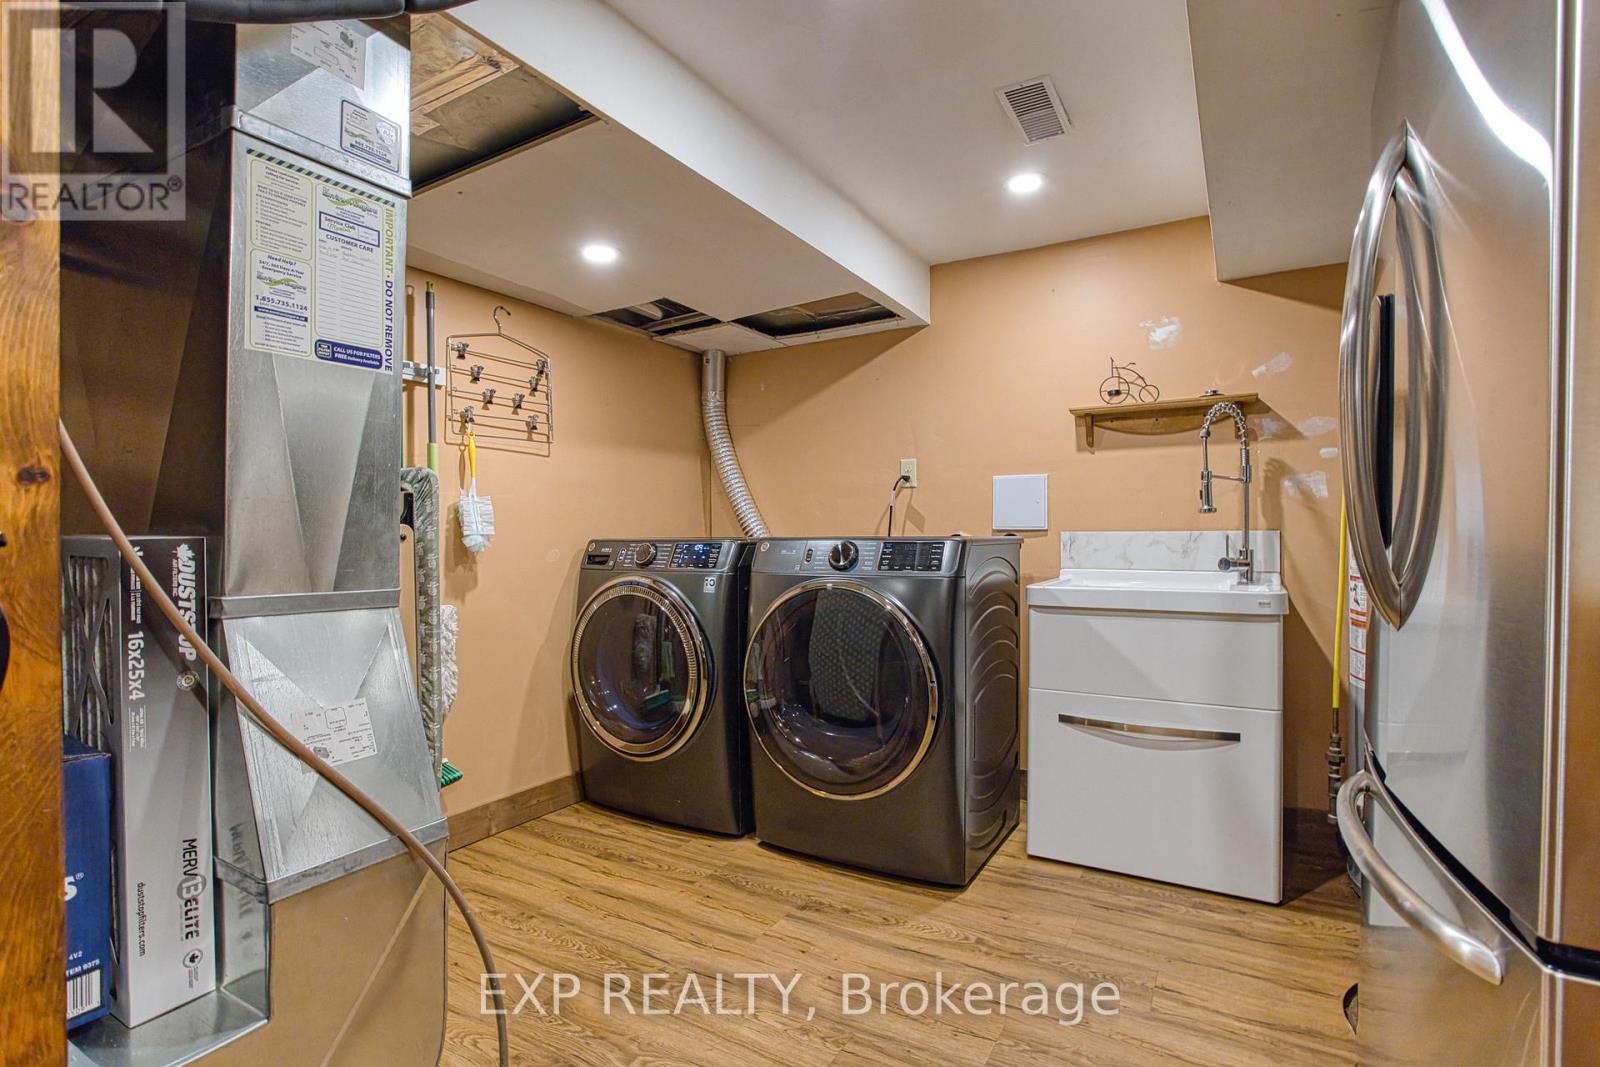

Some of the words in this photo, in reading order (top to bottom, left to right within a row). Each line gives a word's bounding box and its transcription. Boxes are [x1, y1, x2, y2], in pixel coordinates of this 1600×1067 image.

[326, 234, 358, 248] CUSTOMER
[358, 244, 374, 253] CARE
[385, 208, 393, 273] IMPORTANT
[385, 280, 393, 297] DO
[385, 299, 393, 322] NOT
[333, 346, 346, 354] CALL
[363, 352, 380, 360] FILTERS
[384, 324, 393, 372] REMOVE
[127, 631, 146, 701] 16x25x4
[136, 881, 147, 957] duststopfilters.com
